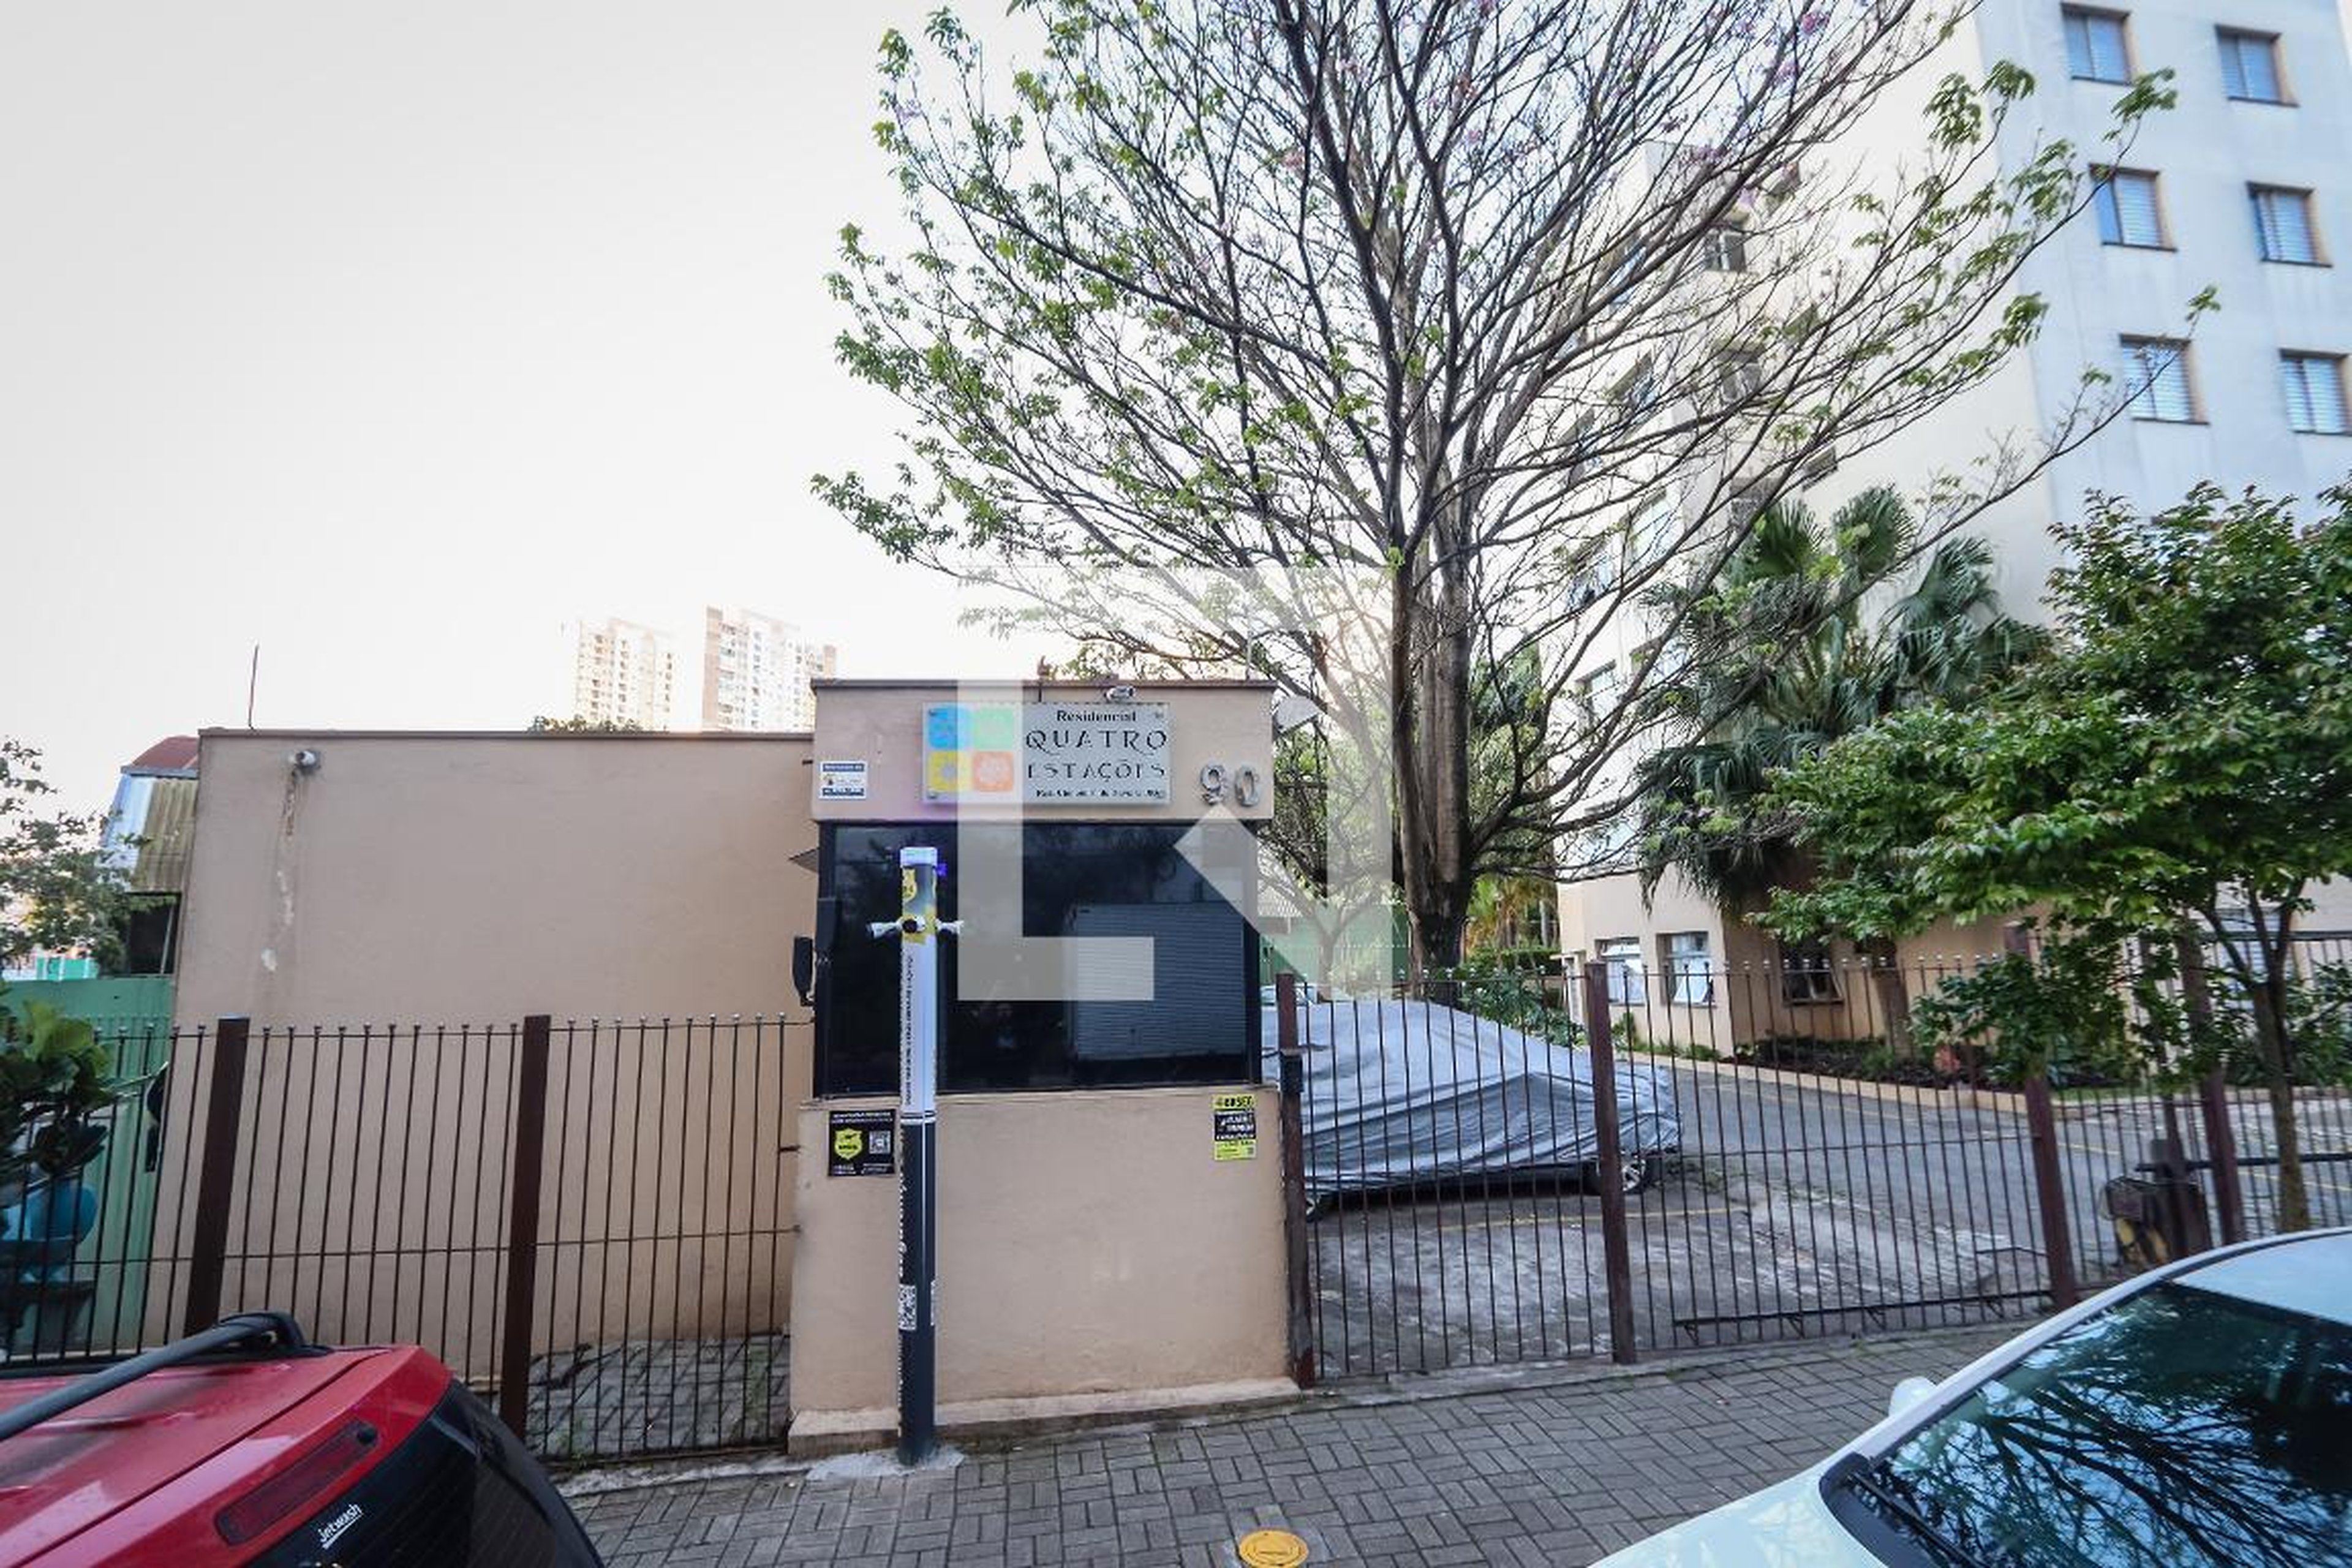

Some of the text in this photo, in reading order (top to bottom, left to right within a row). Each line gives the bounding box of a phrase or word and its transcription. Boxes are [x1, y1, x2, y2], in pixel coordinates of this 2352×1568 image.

[1057, 709, 1136, 722] Residencial
[1025, 729, 1167, 756] QUATRO
[1027, 759, 1166, 782] ESTAÇÕES
[1199, 763, 1261, 807] 90
